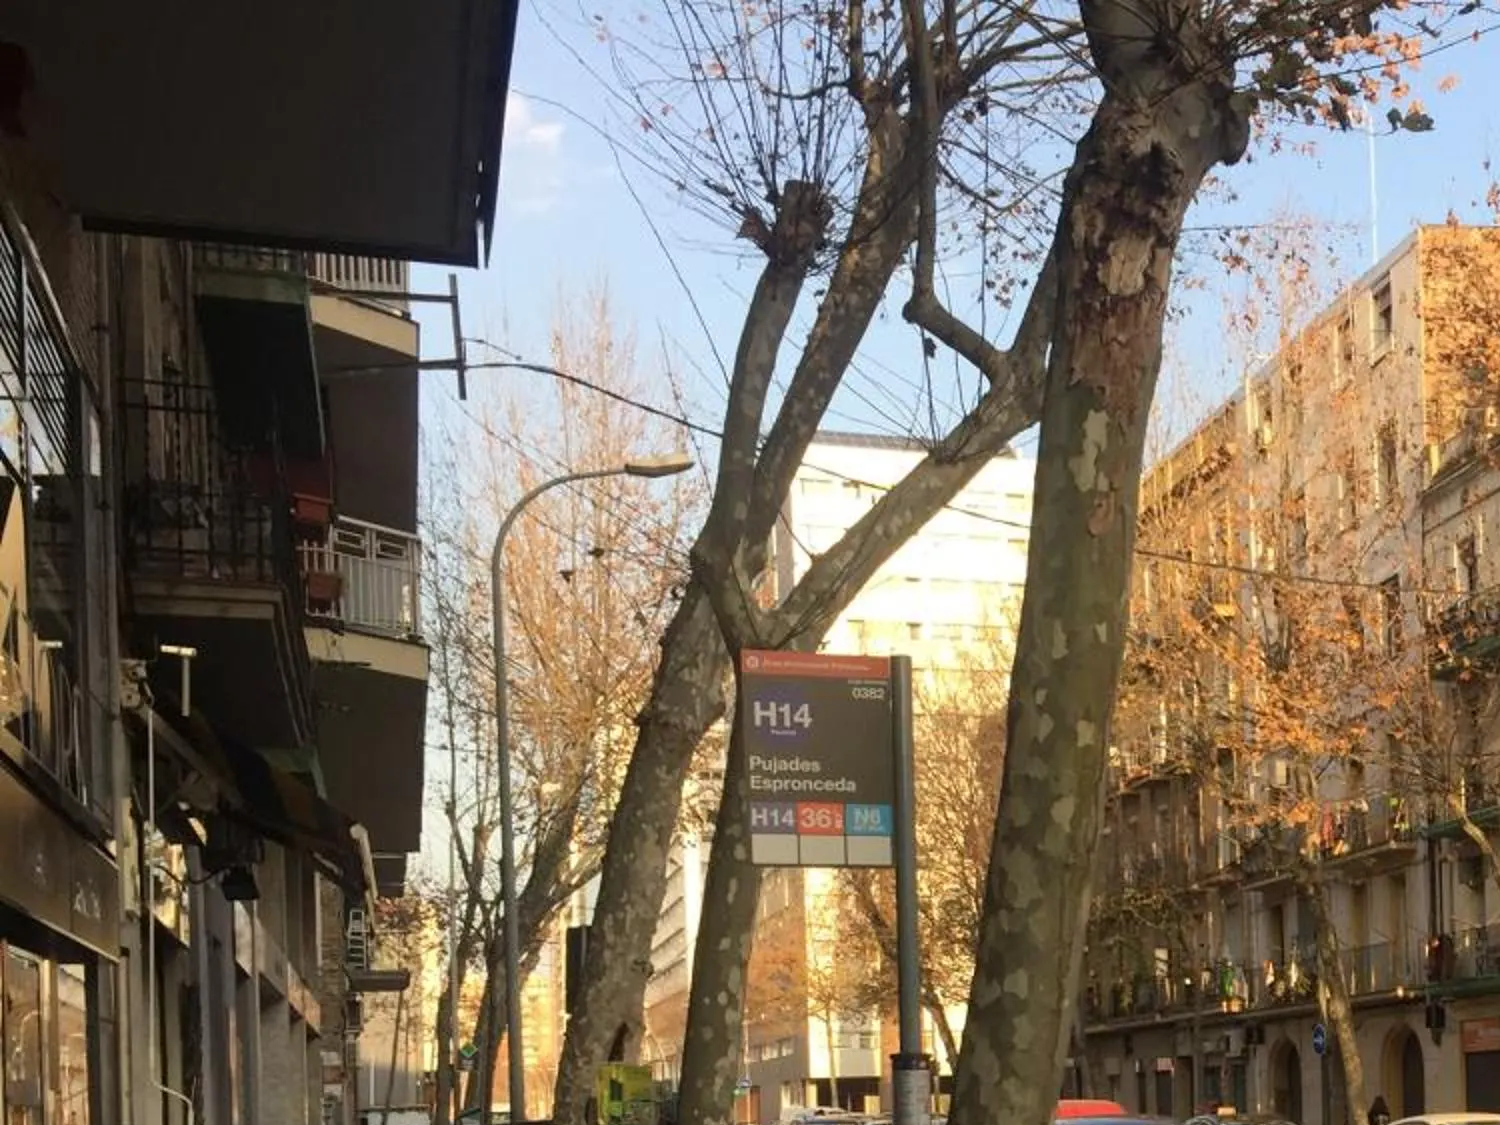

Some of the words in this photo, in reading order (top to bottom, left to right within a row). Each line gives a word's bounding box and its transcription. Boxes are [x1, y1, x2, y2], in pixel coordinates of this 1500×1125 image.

[753, 701, 813, 729] H14
[749, 755, 821, 774] Pujades
[750, 775, 857, 793] Espronceda
[750, 807, 795, 827] H14
[800, 807, 832, 829] 36
